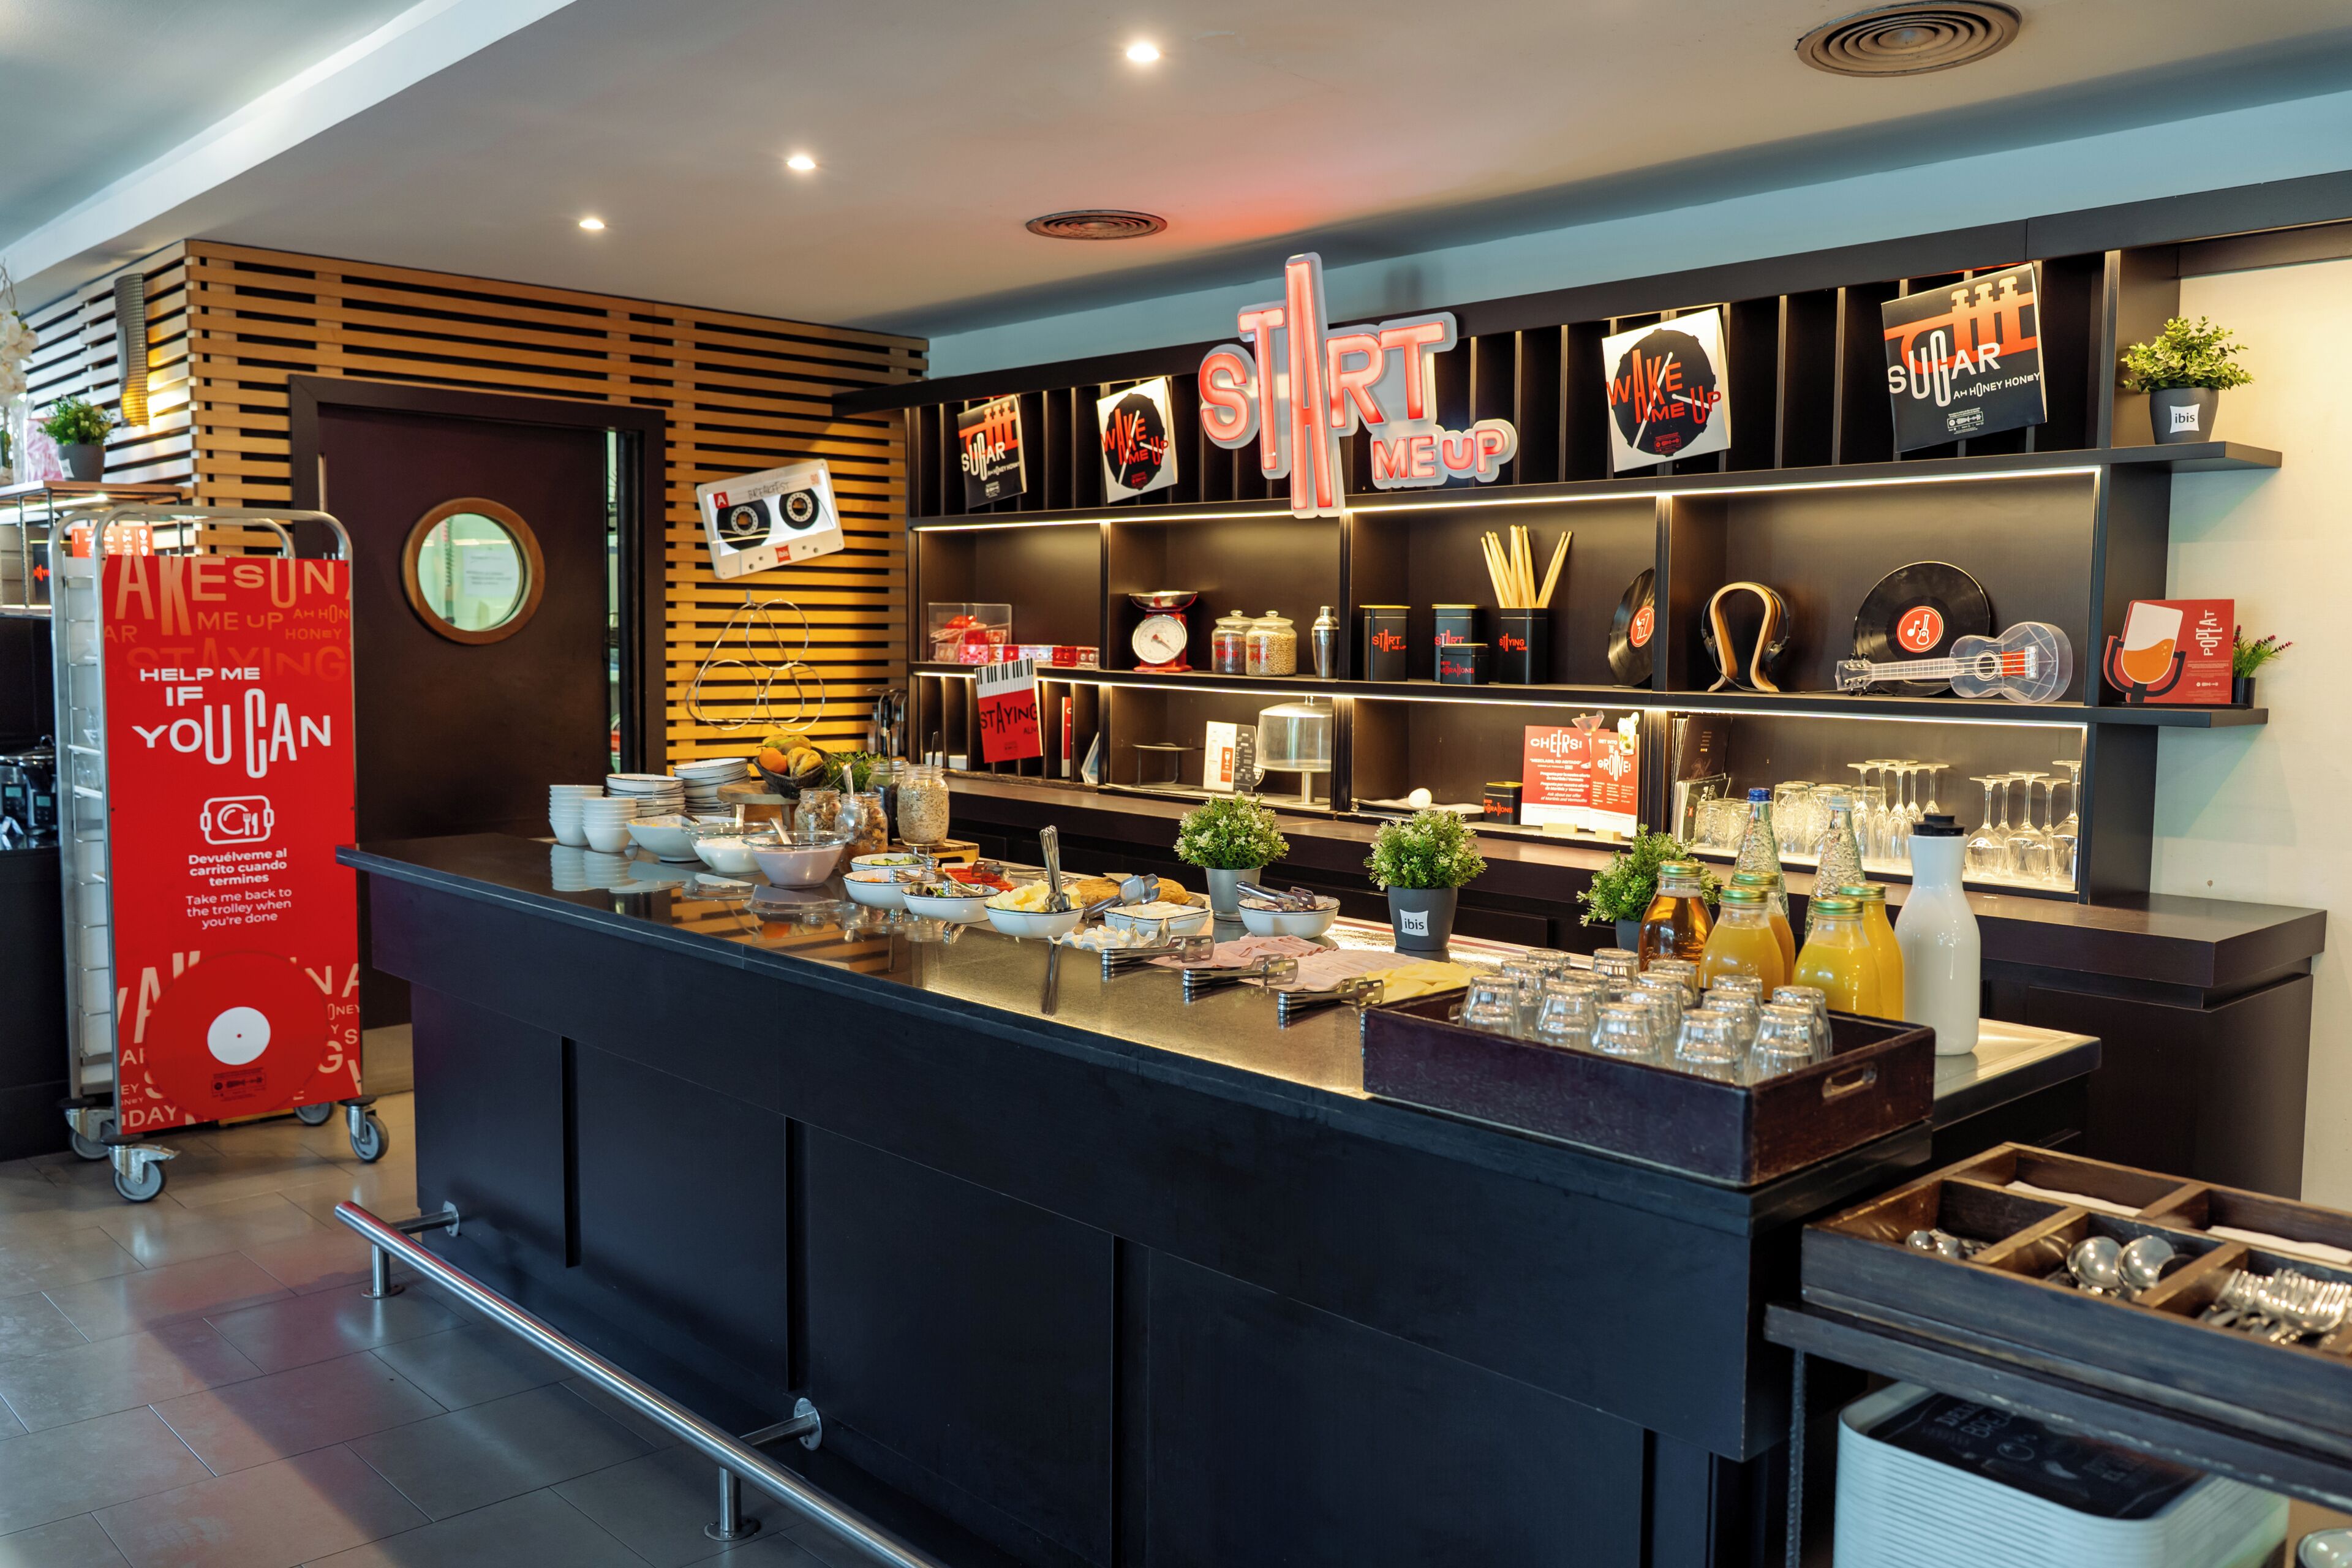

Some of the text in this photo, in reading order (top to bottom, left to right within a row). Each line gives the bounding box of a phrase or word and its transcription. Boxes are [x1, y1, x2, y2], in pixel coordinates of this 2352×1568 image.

[1887, 330, 2001, 407] SUGAR
[1198, 260, 1445, 510] START
[1606, 349, 1683, 423] WAKE
[1969, 382, 2002, 397] HONEY
[2005, 372, 2040, 388] HONEY
[1651, 385, 1721, 424] ME UP
[2174, 412, 2195, 423] ibis
[1101, 408, 1147, 465] WAKE
[961, 432, 1006, 481] SUGAR
[1129, 435, 1169, 465] ME UP
[1373, 429, 1505, 480] ME UP
[717, 494, 727, 506] A
[102, 554, 334, 635] AKE SUN
[197, 611, 238, 630] ME
[247, 612, 284, 630] UP
[285, 628, 342, 639] HONEY
[1372, 629, 1401, 652] START
[140, 667, 260, 681] HELP ME
[165, 686, 203, 707] IF
[980, 702, 1038, 734] STAYING
[132, 688, 331, 778] YOU CAN
[188, 847, 287, 865] Devuélveme al
[189, 859, 287, 876] carrito cuando
[209, 873, 269, 886] termines
[186, 889, 292, 905] Take me back to
[186, 900, 292, 918] the trolley when
[202, 913, 277, 930] you're done
[1404, 918, 1425, 930] ibis
